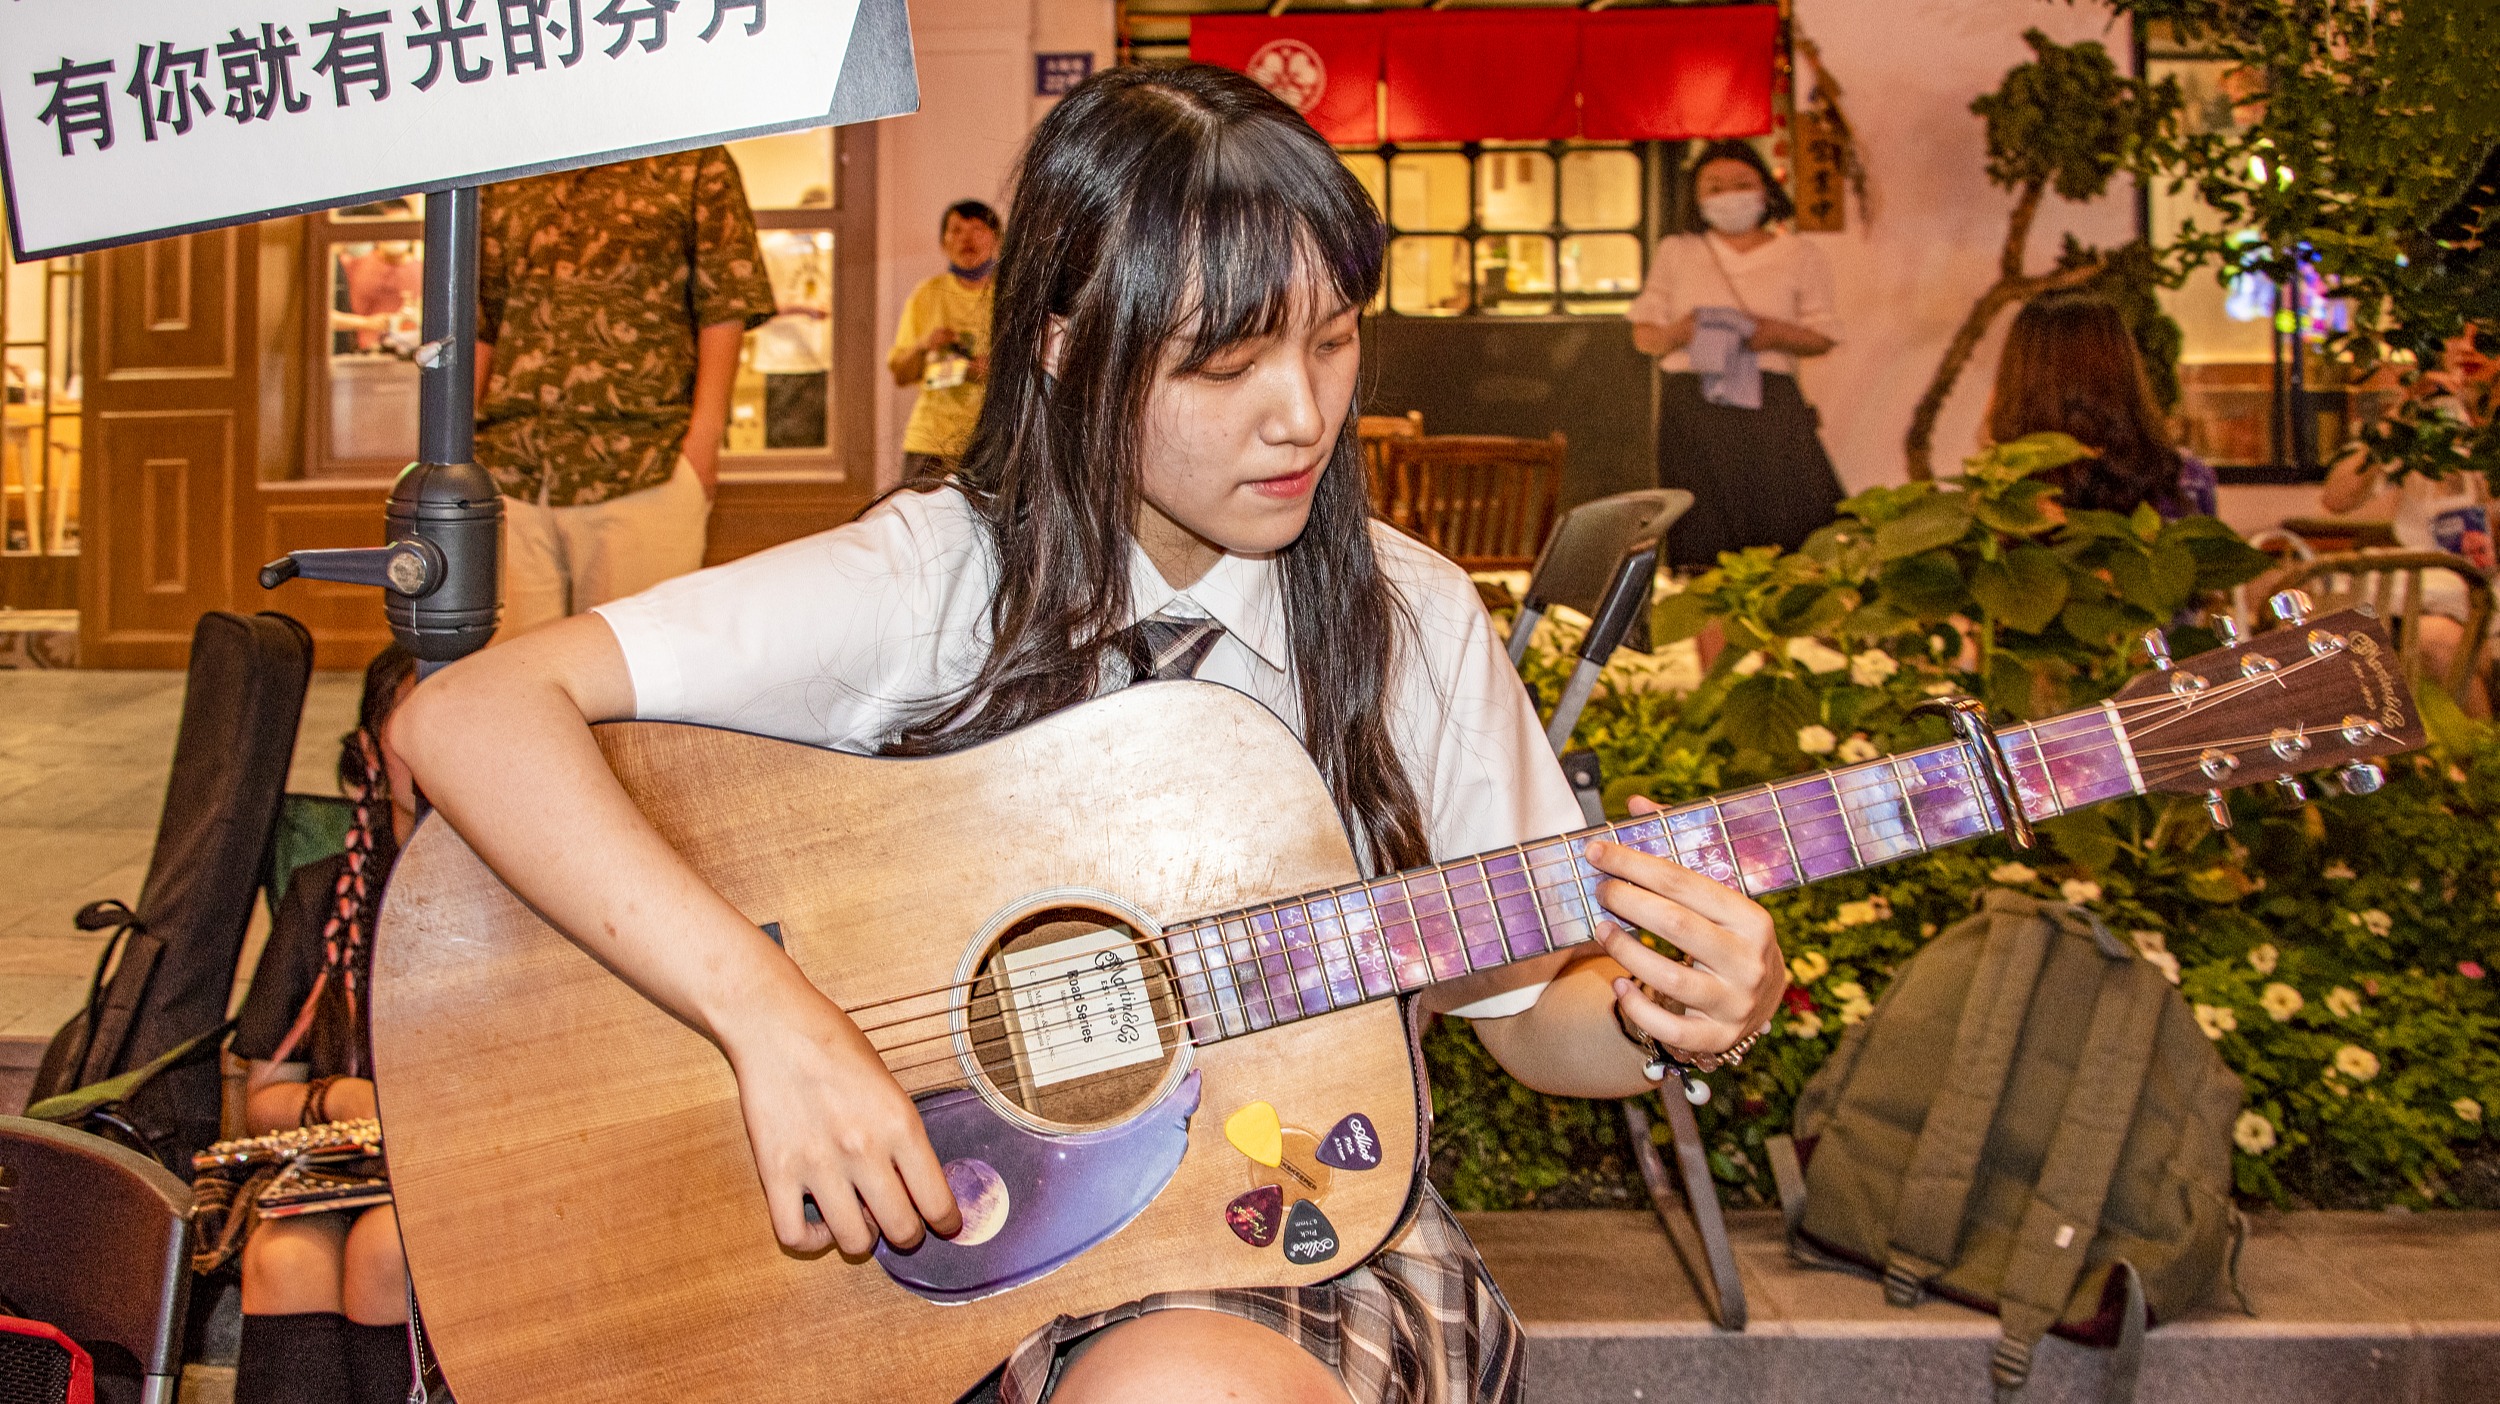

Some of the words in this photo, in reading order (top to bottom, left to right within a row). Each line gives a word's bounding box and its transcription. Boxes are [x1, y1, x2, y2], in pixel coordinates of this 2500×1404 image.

[1067, 969, 1085, 1002] Road
[1075, 1003, 1093, 1043] Series
[1344, 1136, 1355, 1155] Pick
[1300, 1229, 1317, 1238] Pick
